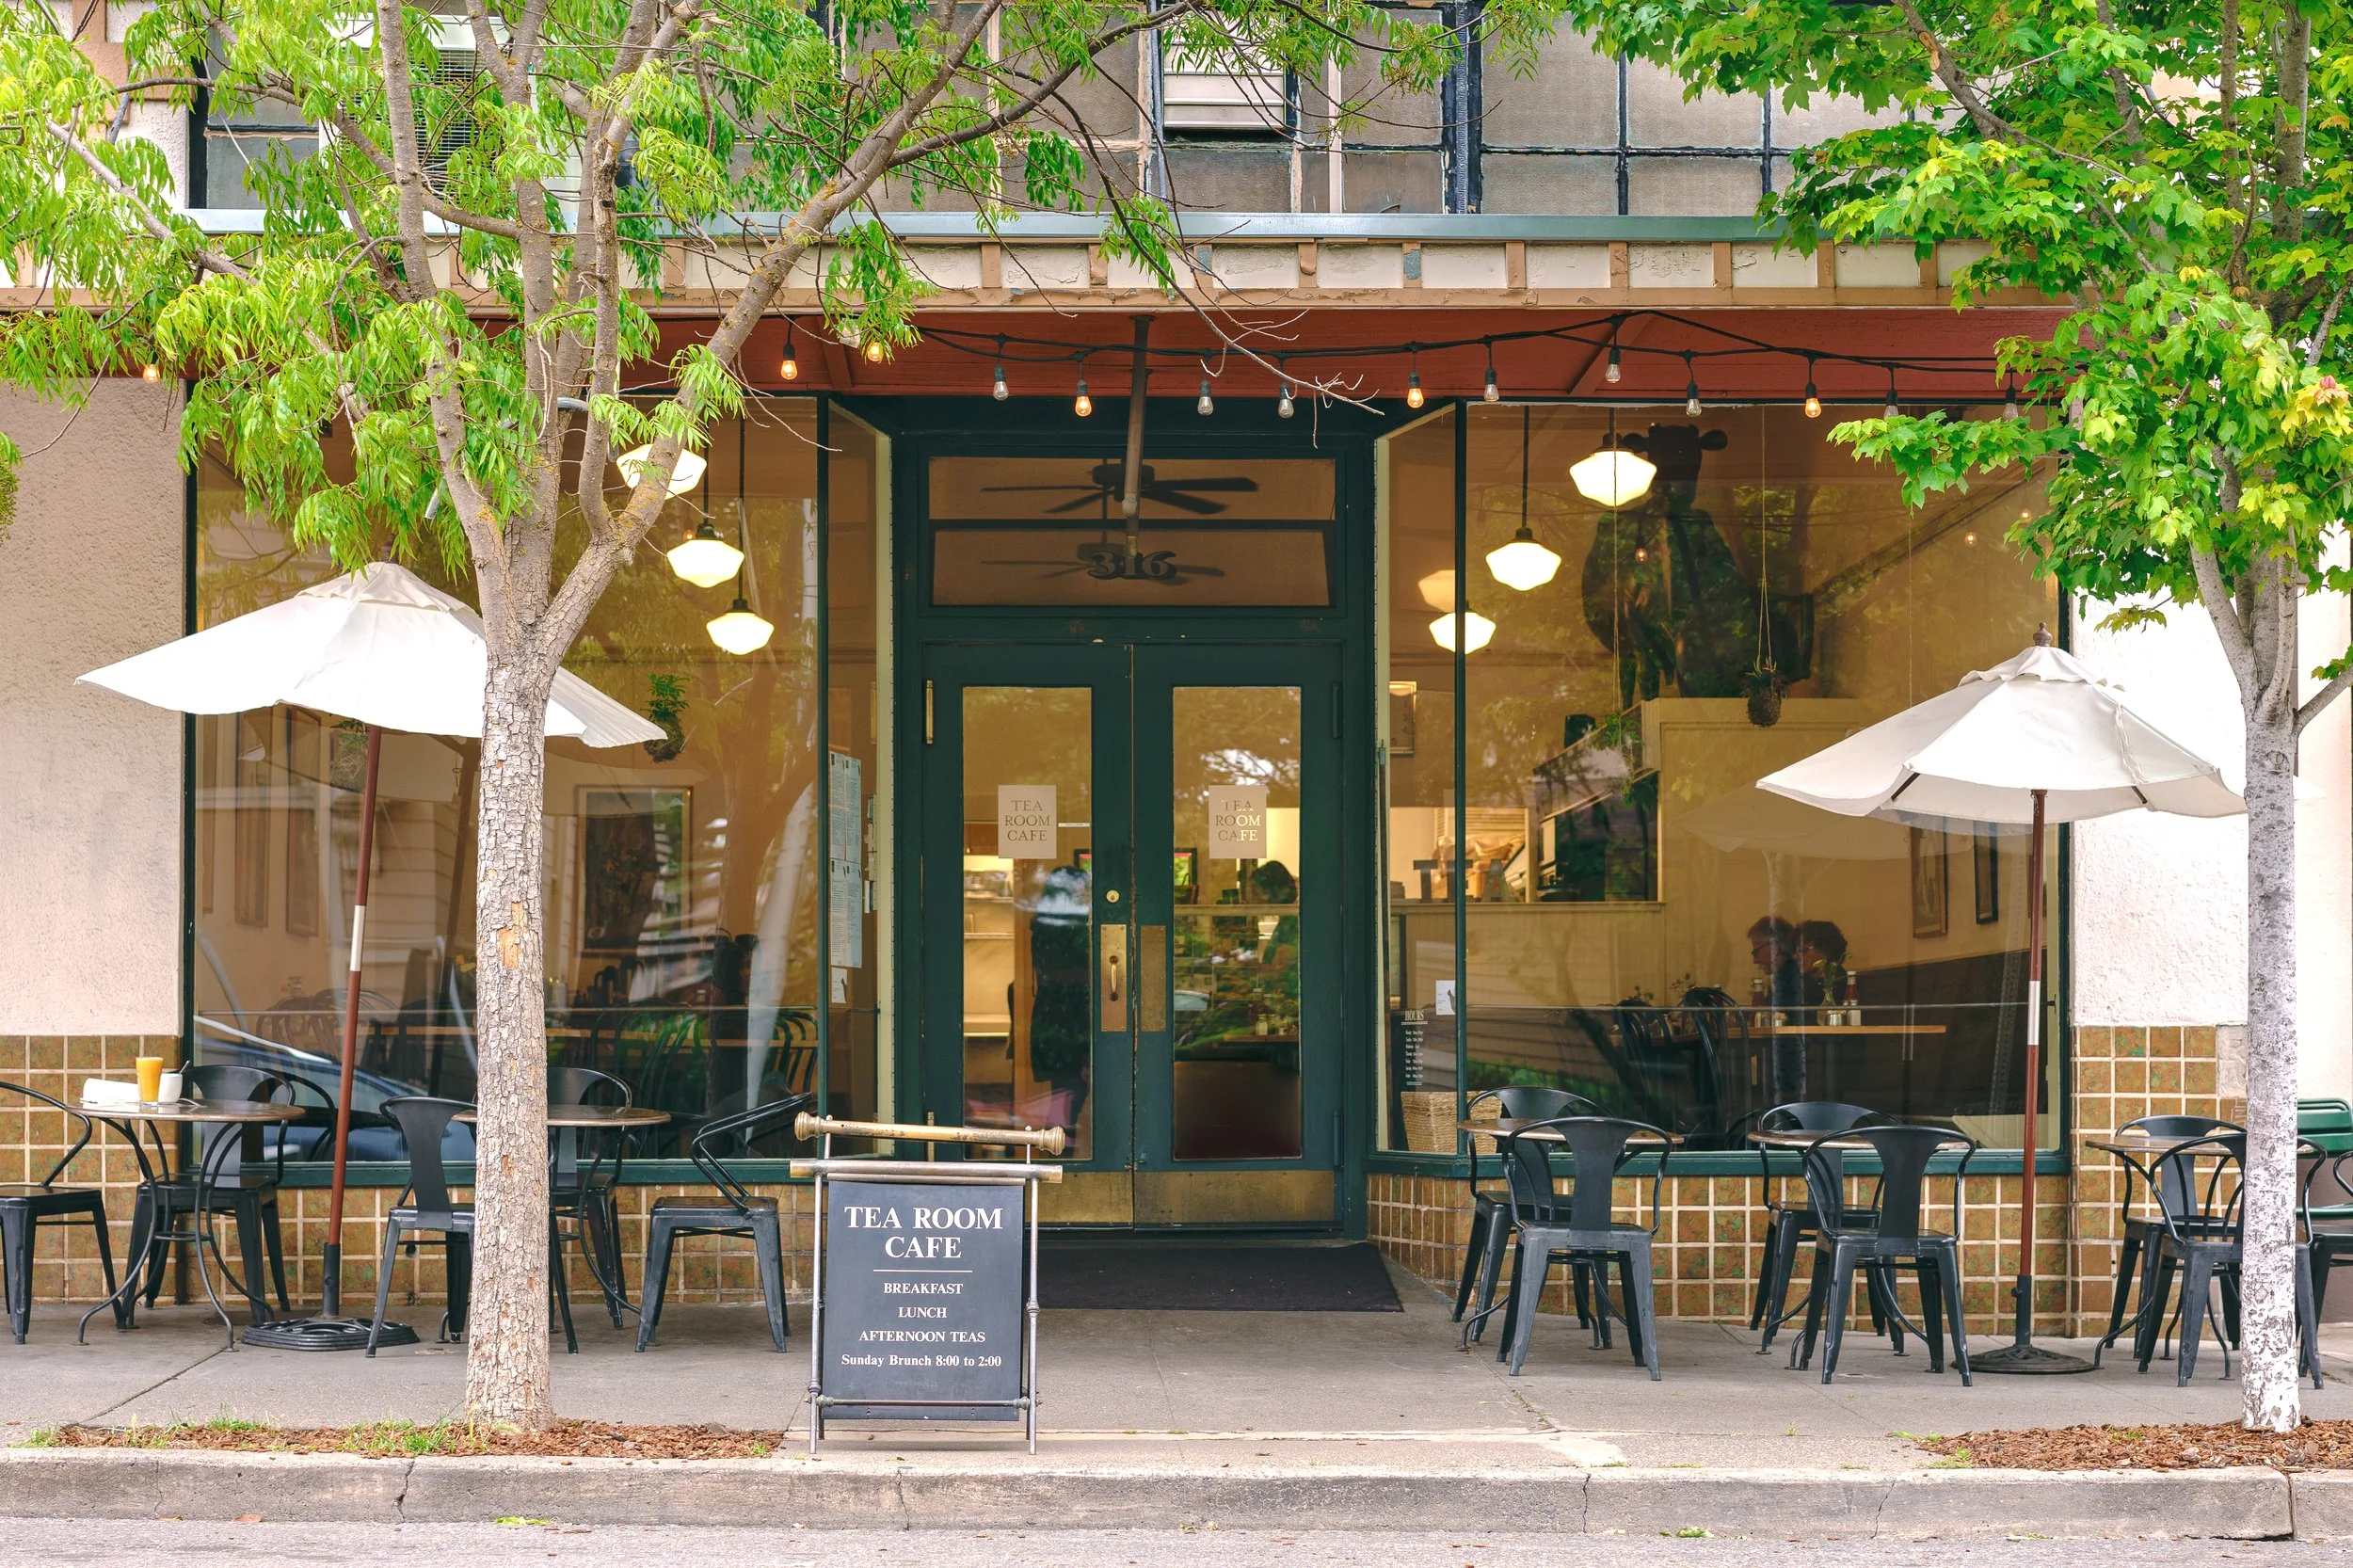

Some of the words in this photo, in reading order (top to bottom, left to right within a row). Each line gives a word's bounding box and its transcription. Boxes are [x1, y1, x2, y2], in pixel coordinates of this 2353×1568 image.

[1087, 550, 1176, 580] 316
[1011, 799, 1043, 811] TEA
[1220, 799, 1254, 811] TEA
[1004, 814, 1050, 826] ROOM
[1215, 814, 1261, 826] ROOM
[1007, 829, 1048, 841] CAFE
[1218, 829, 1258, 841] CAFE
[1404, 1009, 1425, 1021] HOURS
[844, 1206, 903, 1229] TEA
[912, 1206, 1003, 1230] ROOM
[885, 1236, 962, 1258] CAFE
[883, 1282, 964, 1295] BREAKFAST
[898, 1306, 948, 1319] LUNCH
[858, 1330, 946, 1343] AFTERNOON
[950, 1331, 986, 1343] TEAS
[841, 1353, 885, 1368] Sunday
[888, 1354, 932, 1367] Brunch
[936, 1354, 960, 1367] 8:00
[964, 1356, 975, 1367] to
[977, 1355, 1002, 1368] 2:00
